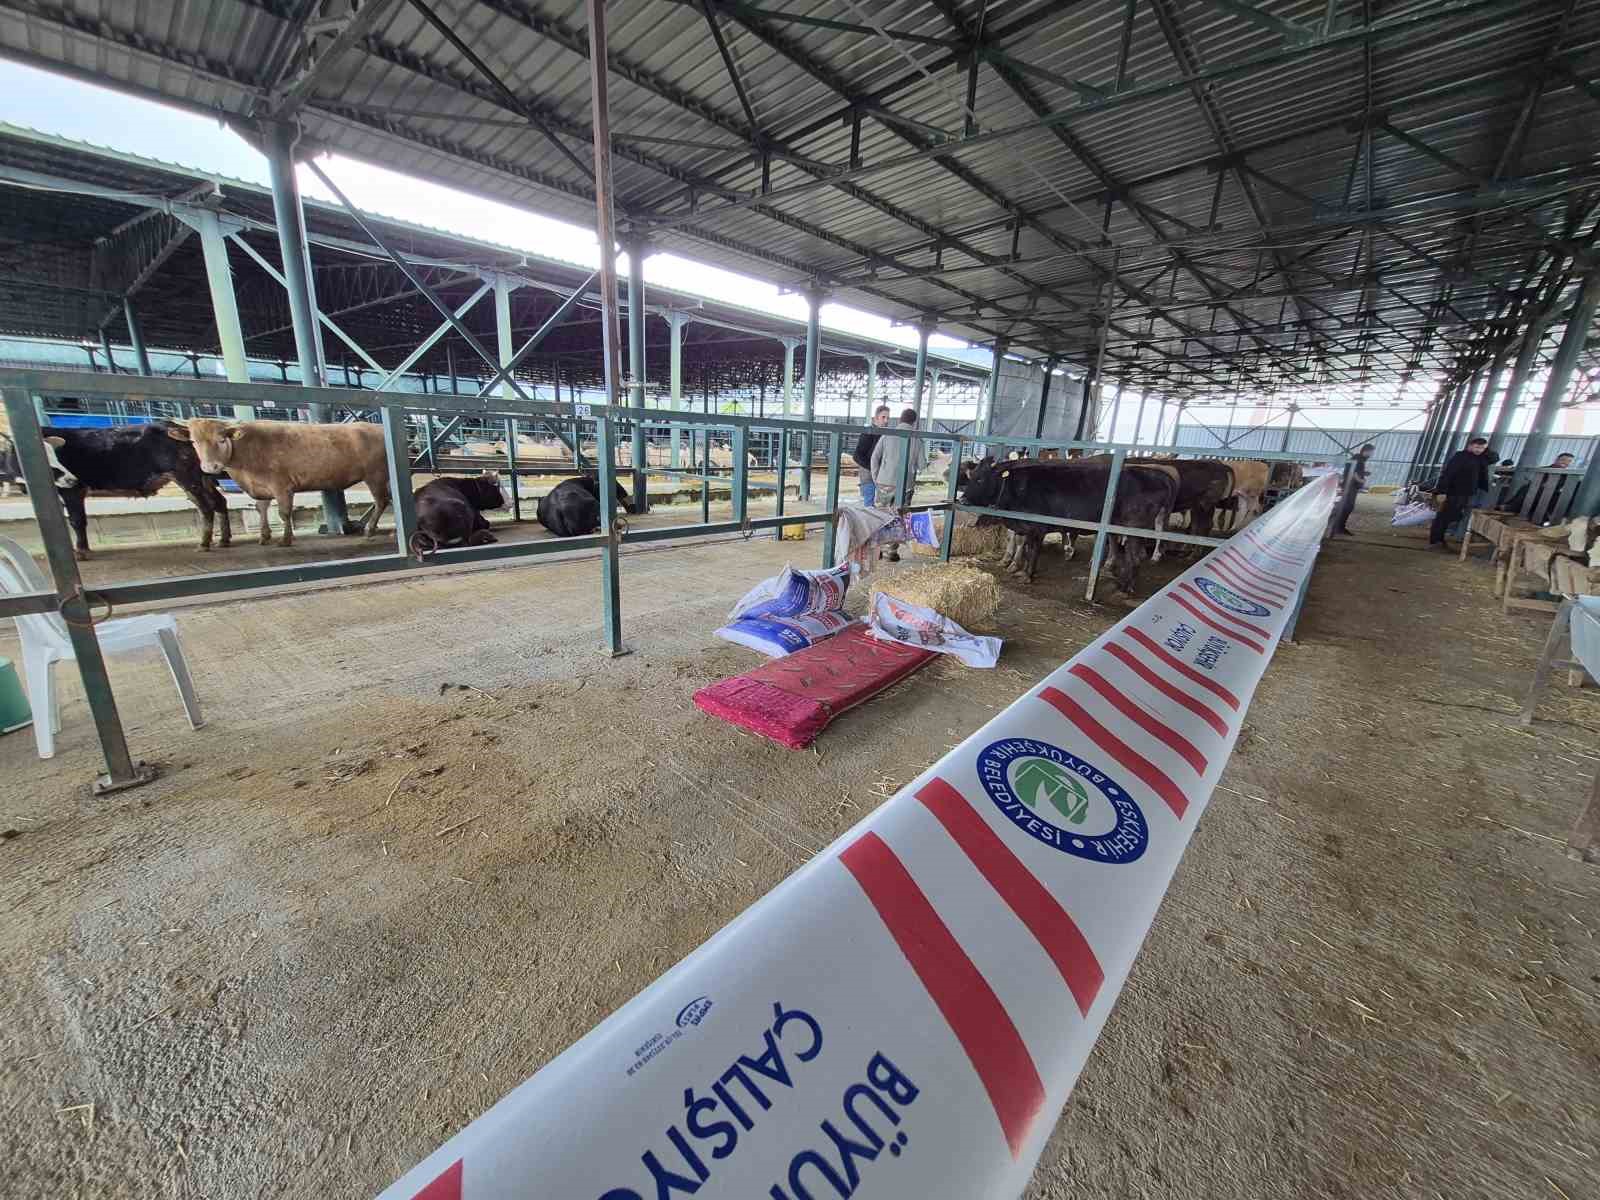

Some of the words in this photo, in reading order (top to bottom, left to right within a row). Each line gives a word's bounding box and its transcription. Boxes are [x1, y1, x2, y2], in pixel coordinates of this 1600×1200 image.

[989, 739, 1106, 784] BÜYÜKŞEHİR
[1090, 799, 1144, 859] ESKİŞEHİR
[769, 1050, 921, 1200] BÜYÜ
